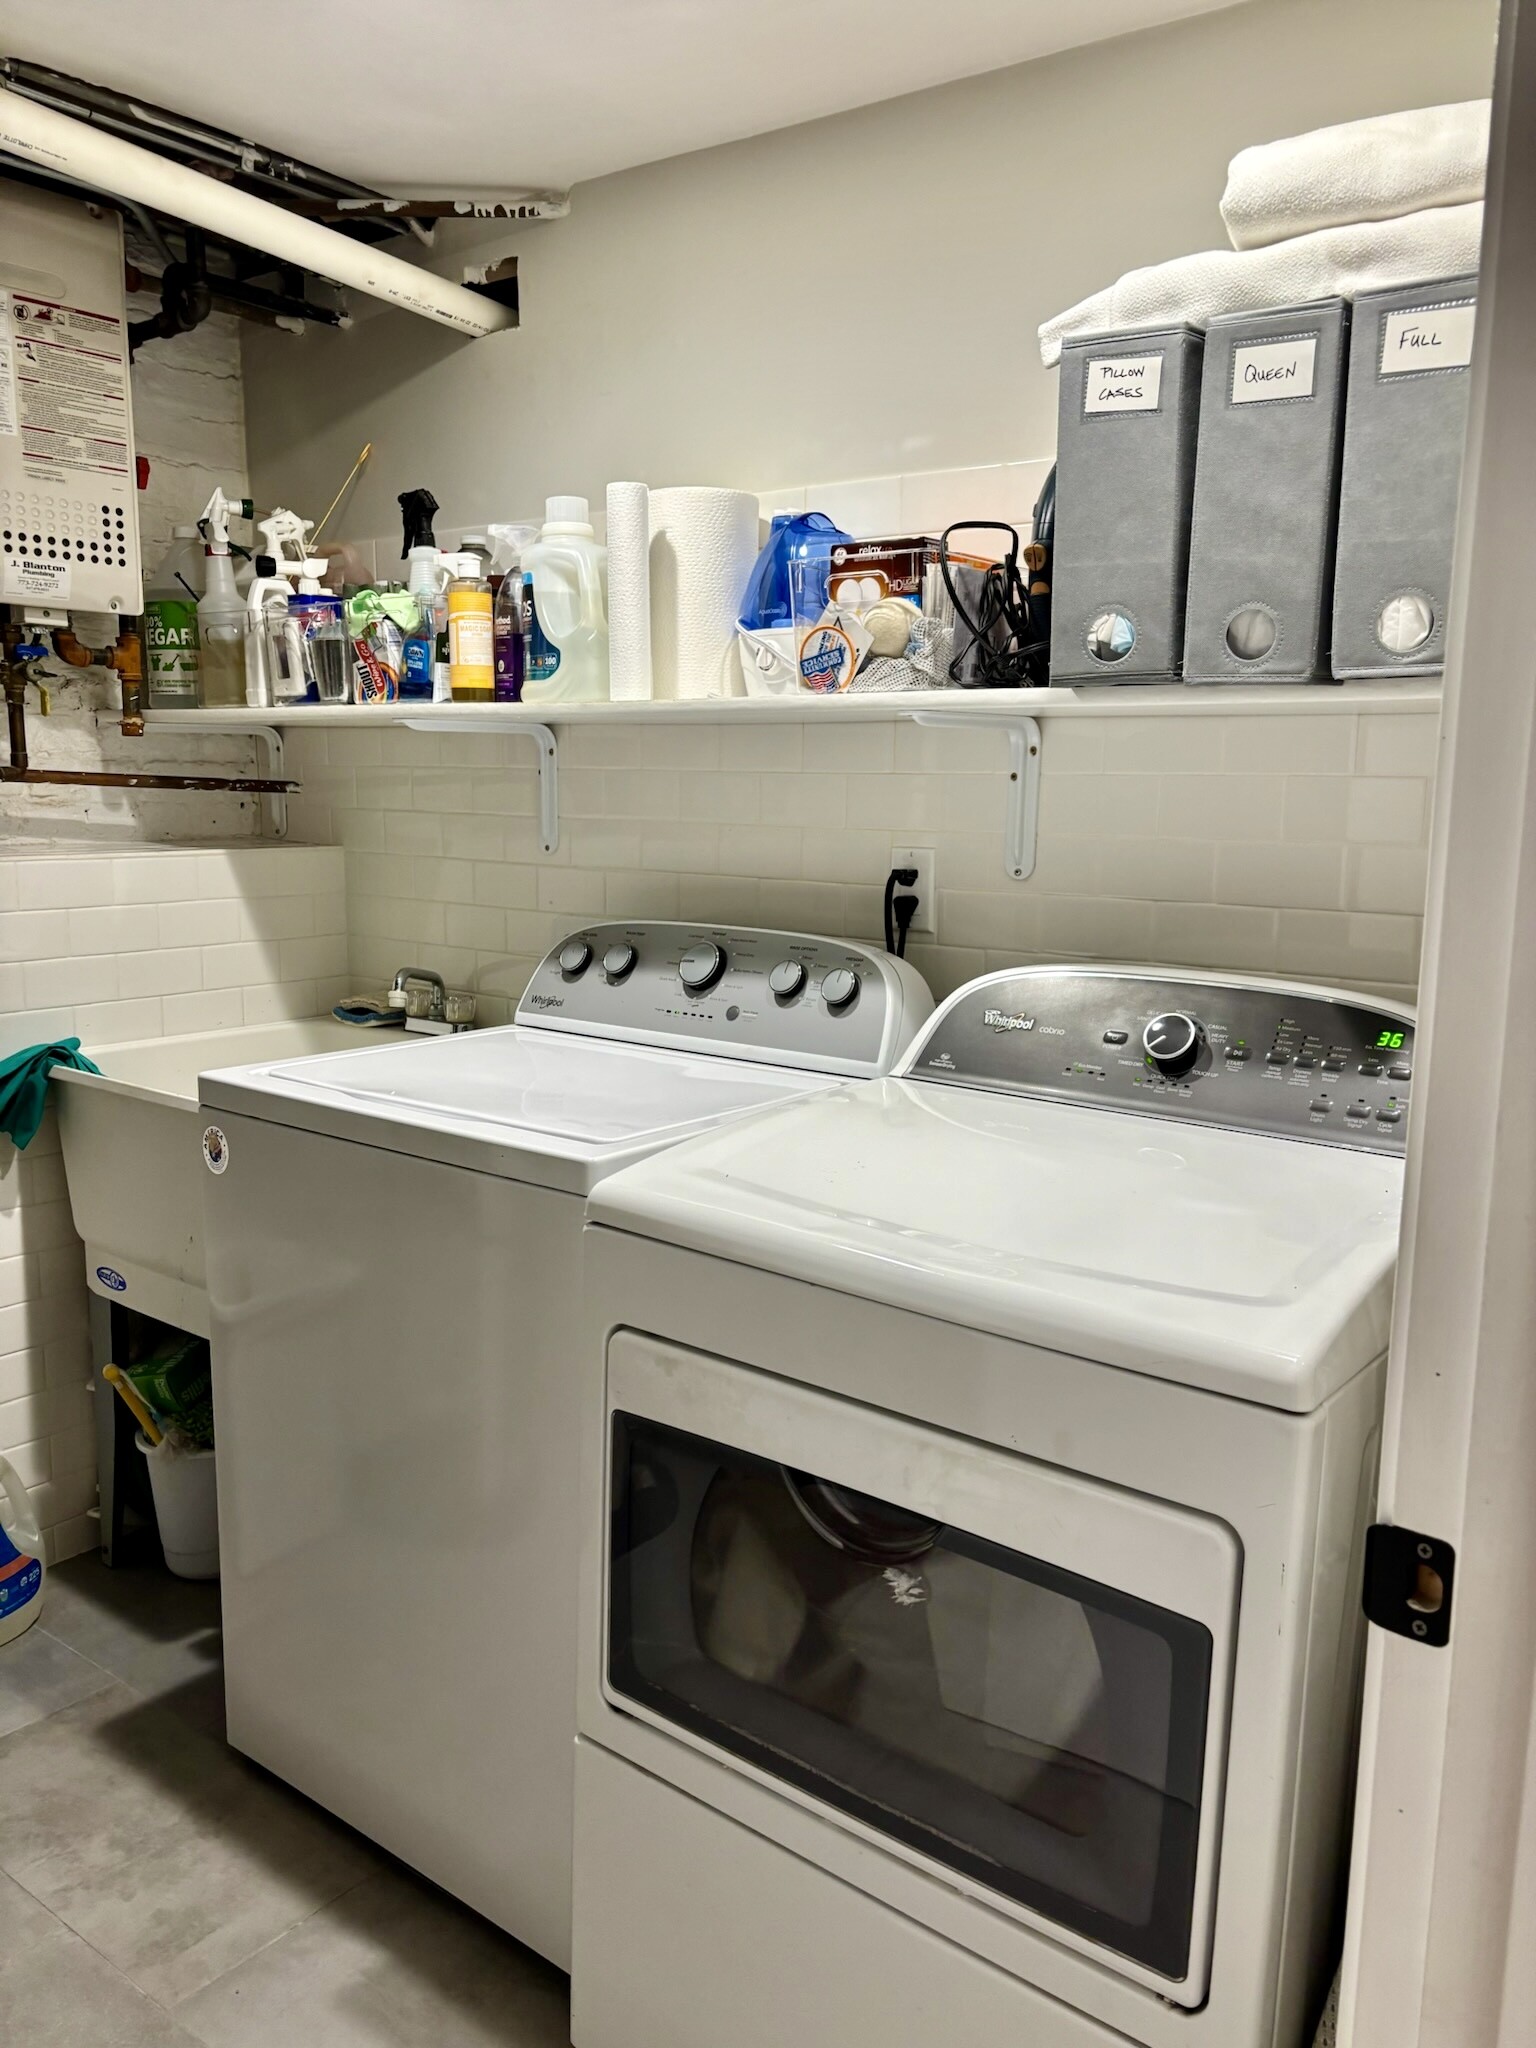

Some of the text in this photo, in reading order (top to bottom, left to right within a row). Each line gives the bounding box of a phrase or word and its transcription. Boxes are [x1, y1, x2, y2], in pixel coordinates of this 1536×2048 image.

[1398, 327, 1442, 350] FULL
[1100, 365, 1145, 380] PILLOW
[1243, 361, 1298, 384] QUEEN
[1098, 388, 1143, 400] CASES
[10, 560, 66, 572] J. Blanton
[22, 569, 55, 578] Plumbing
[889, 579, 902, 592] HD
[360, 643, 370, 656] Go
[544, 656, 556, 665] 100
[802, 650, 841, 667] SERVICE
[804, 656, 842, 674] COMMUNITY
[356, 664, 378, 699] SHOUT
[531, 994, 565, 1009] Whirlpool
[984, 1010, 1066, 1036] Whirlpool cabrio
[1376, 1031, 1404, 1048] 36
